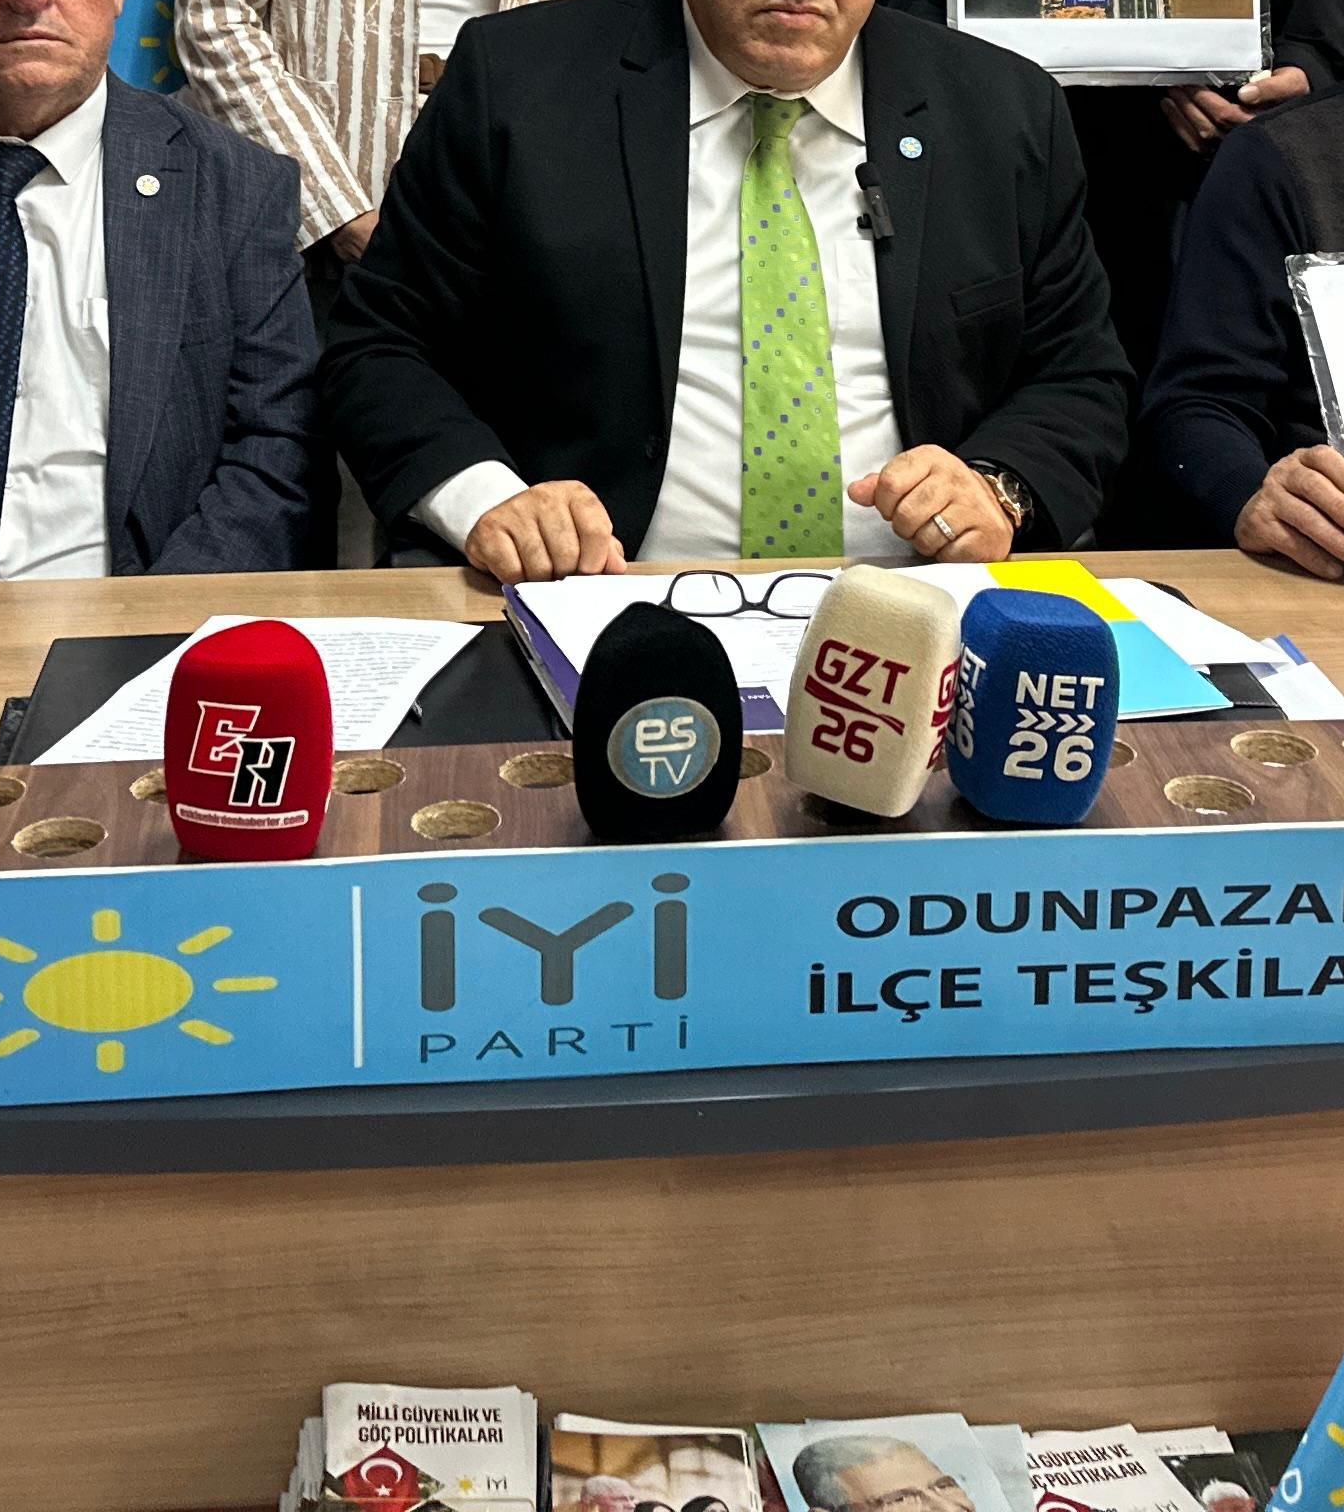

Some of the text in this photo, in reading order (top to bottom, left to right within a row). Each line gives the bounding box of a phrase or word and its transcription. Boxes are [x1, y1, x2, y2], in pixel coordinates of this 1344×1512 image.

[815, 639, 912, 704] GZT
[1015, 671, 1105, 710] NET
[811, 705, 879, 763] 26
[640, 754, 691, 786] TV
[1003, 730, 1094, 782] 26
[417, 872, 690, 1012] İYİ
[809, 962, 982, 1023] İLÇE
[420, 1015, 688, 1063] PARTİ
[359, 1426, 504, 1445] GÖÇ POLİTİKALARI
[402, 1405, 479, 1423] GÜVENLİK
[482, 1408, 501, 1423] VE
[1038, 1445, 1113, 1468] GÜVENLİK
[1109, 1443, 1133, 1458] VE
[1044, 1460, 1147, 1487] POLİTİKALARI
